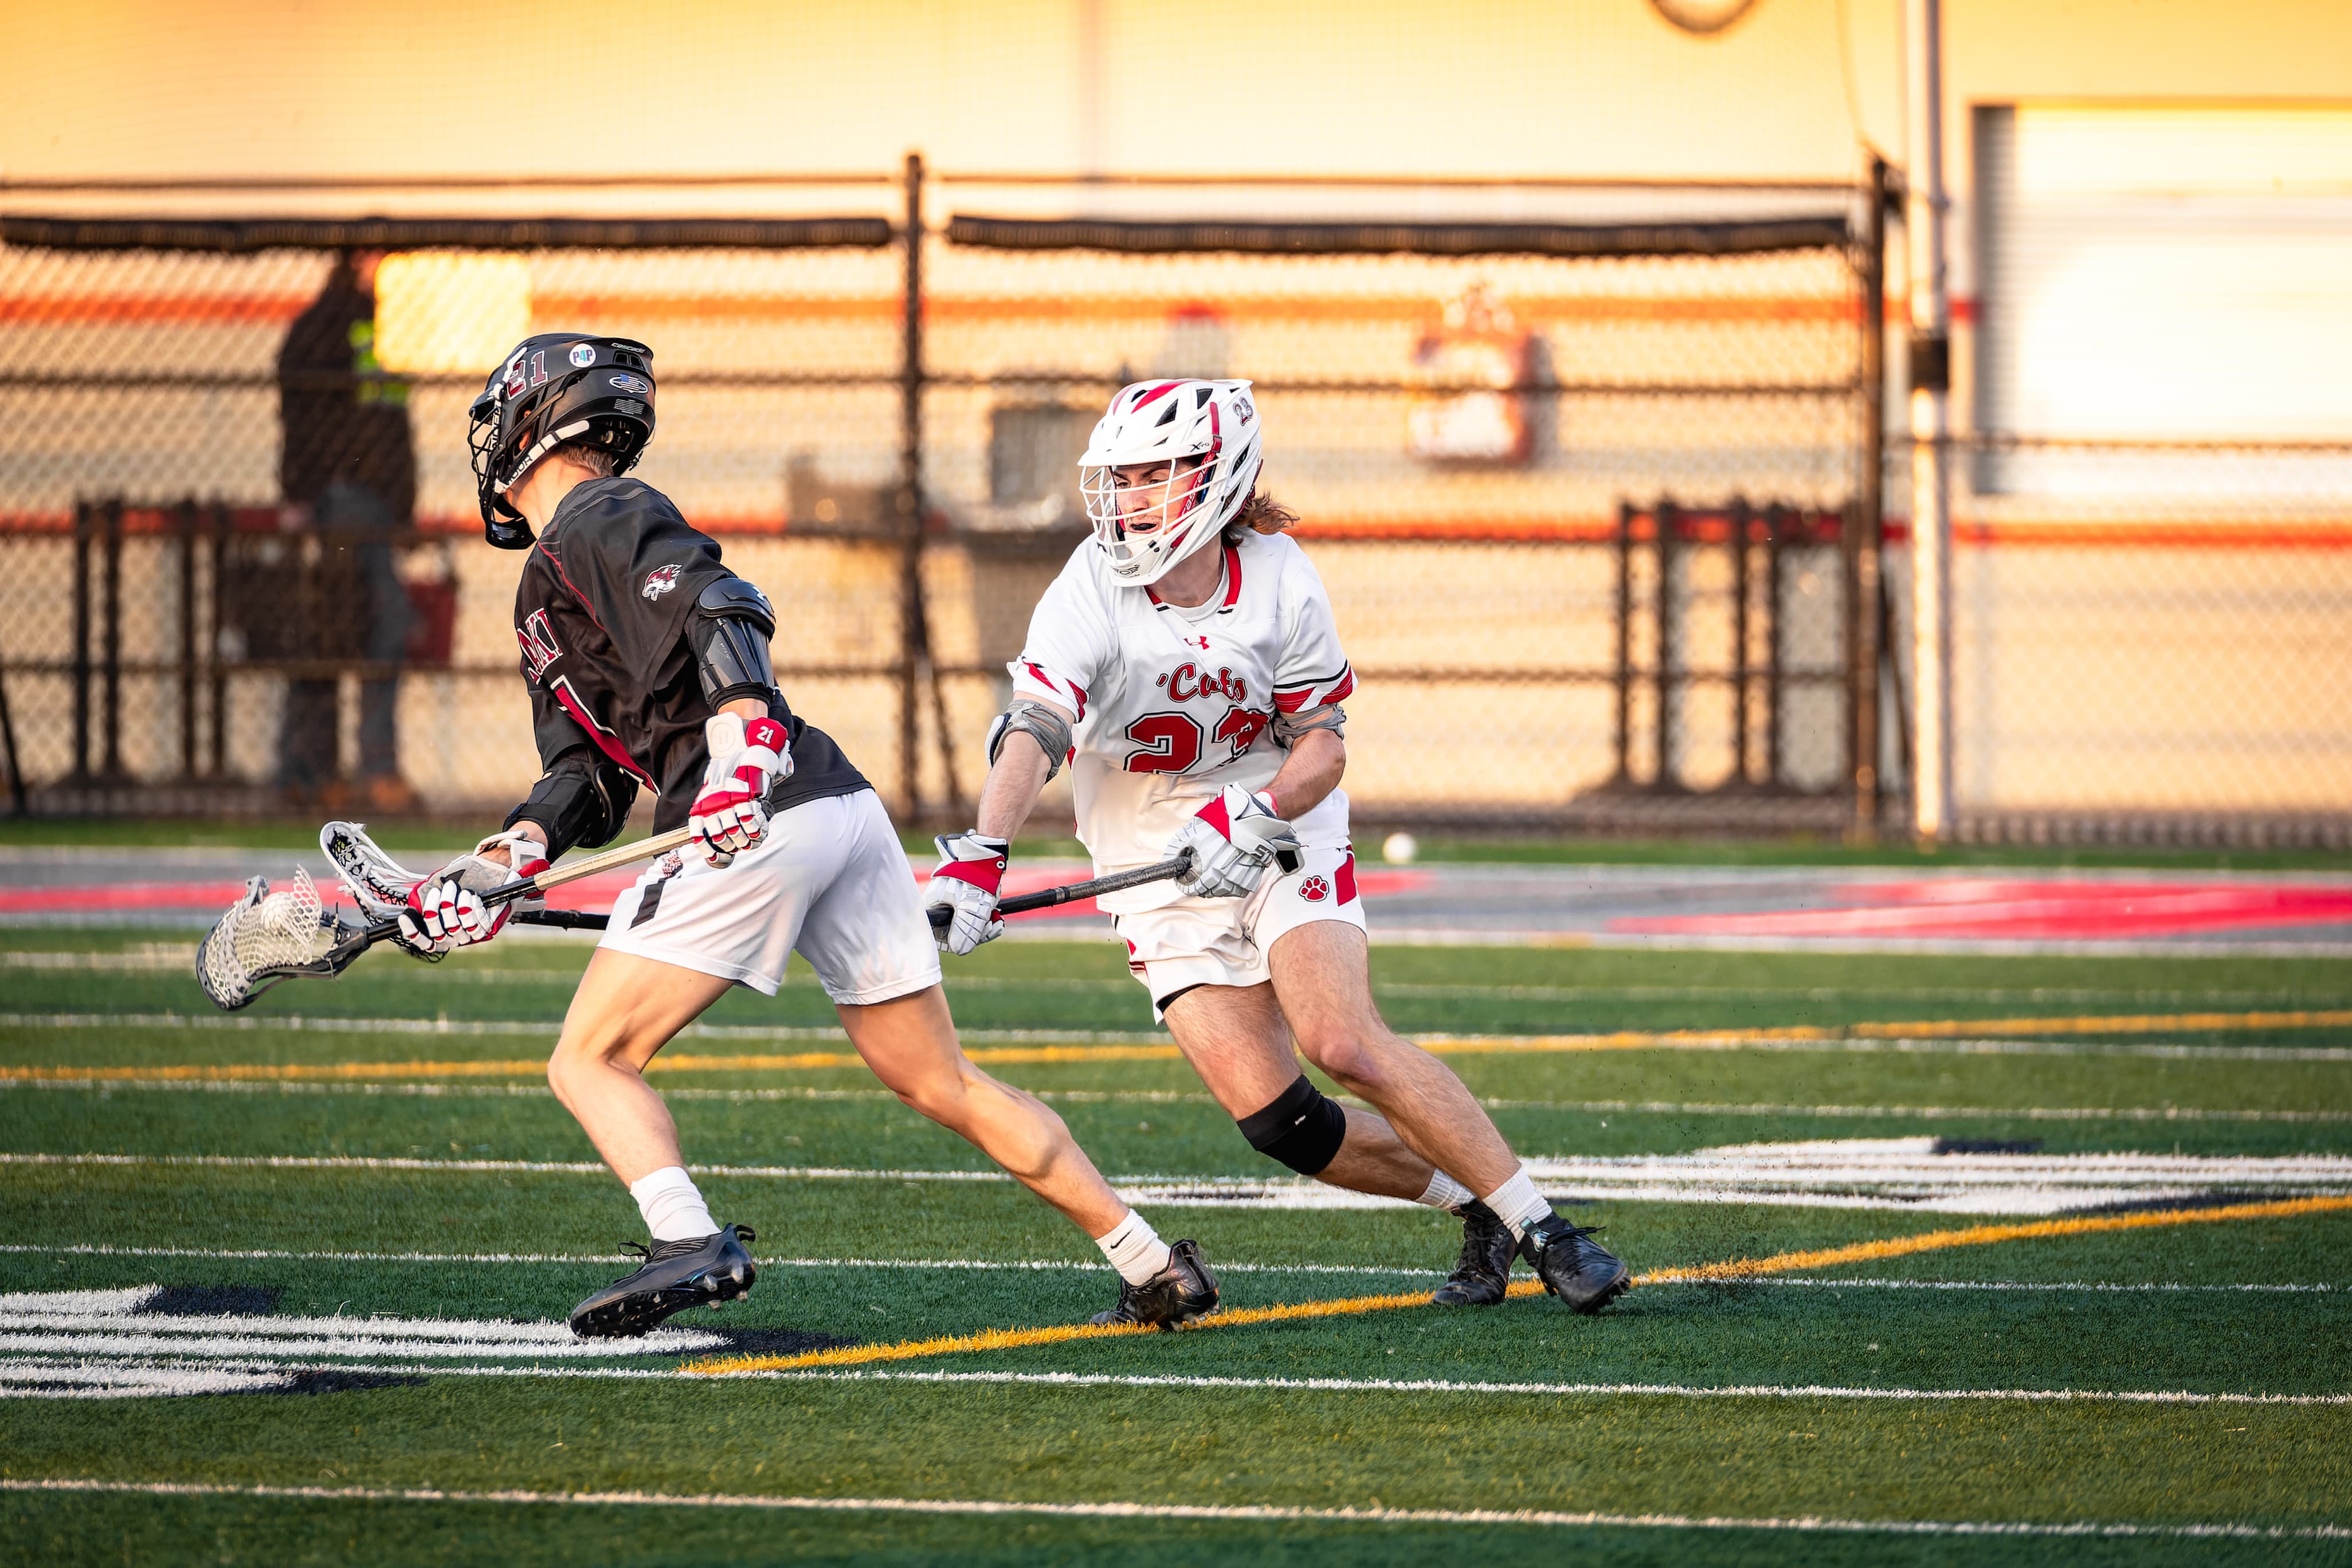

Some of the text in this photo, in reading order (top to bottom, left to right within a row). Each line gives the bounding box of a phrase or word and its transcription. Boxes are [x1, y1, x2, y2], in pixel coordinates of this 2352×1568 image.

[573, 349, 593, 363] P4P
[507, 350, 548, 400] 21
[1233, 397, 1253, 426] 23
[756, 726, 774, 744] 21
